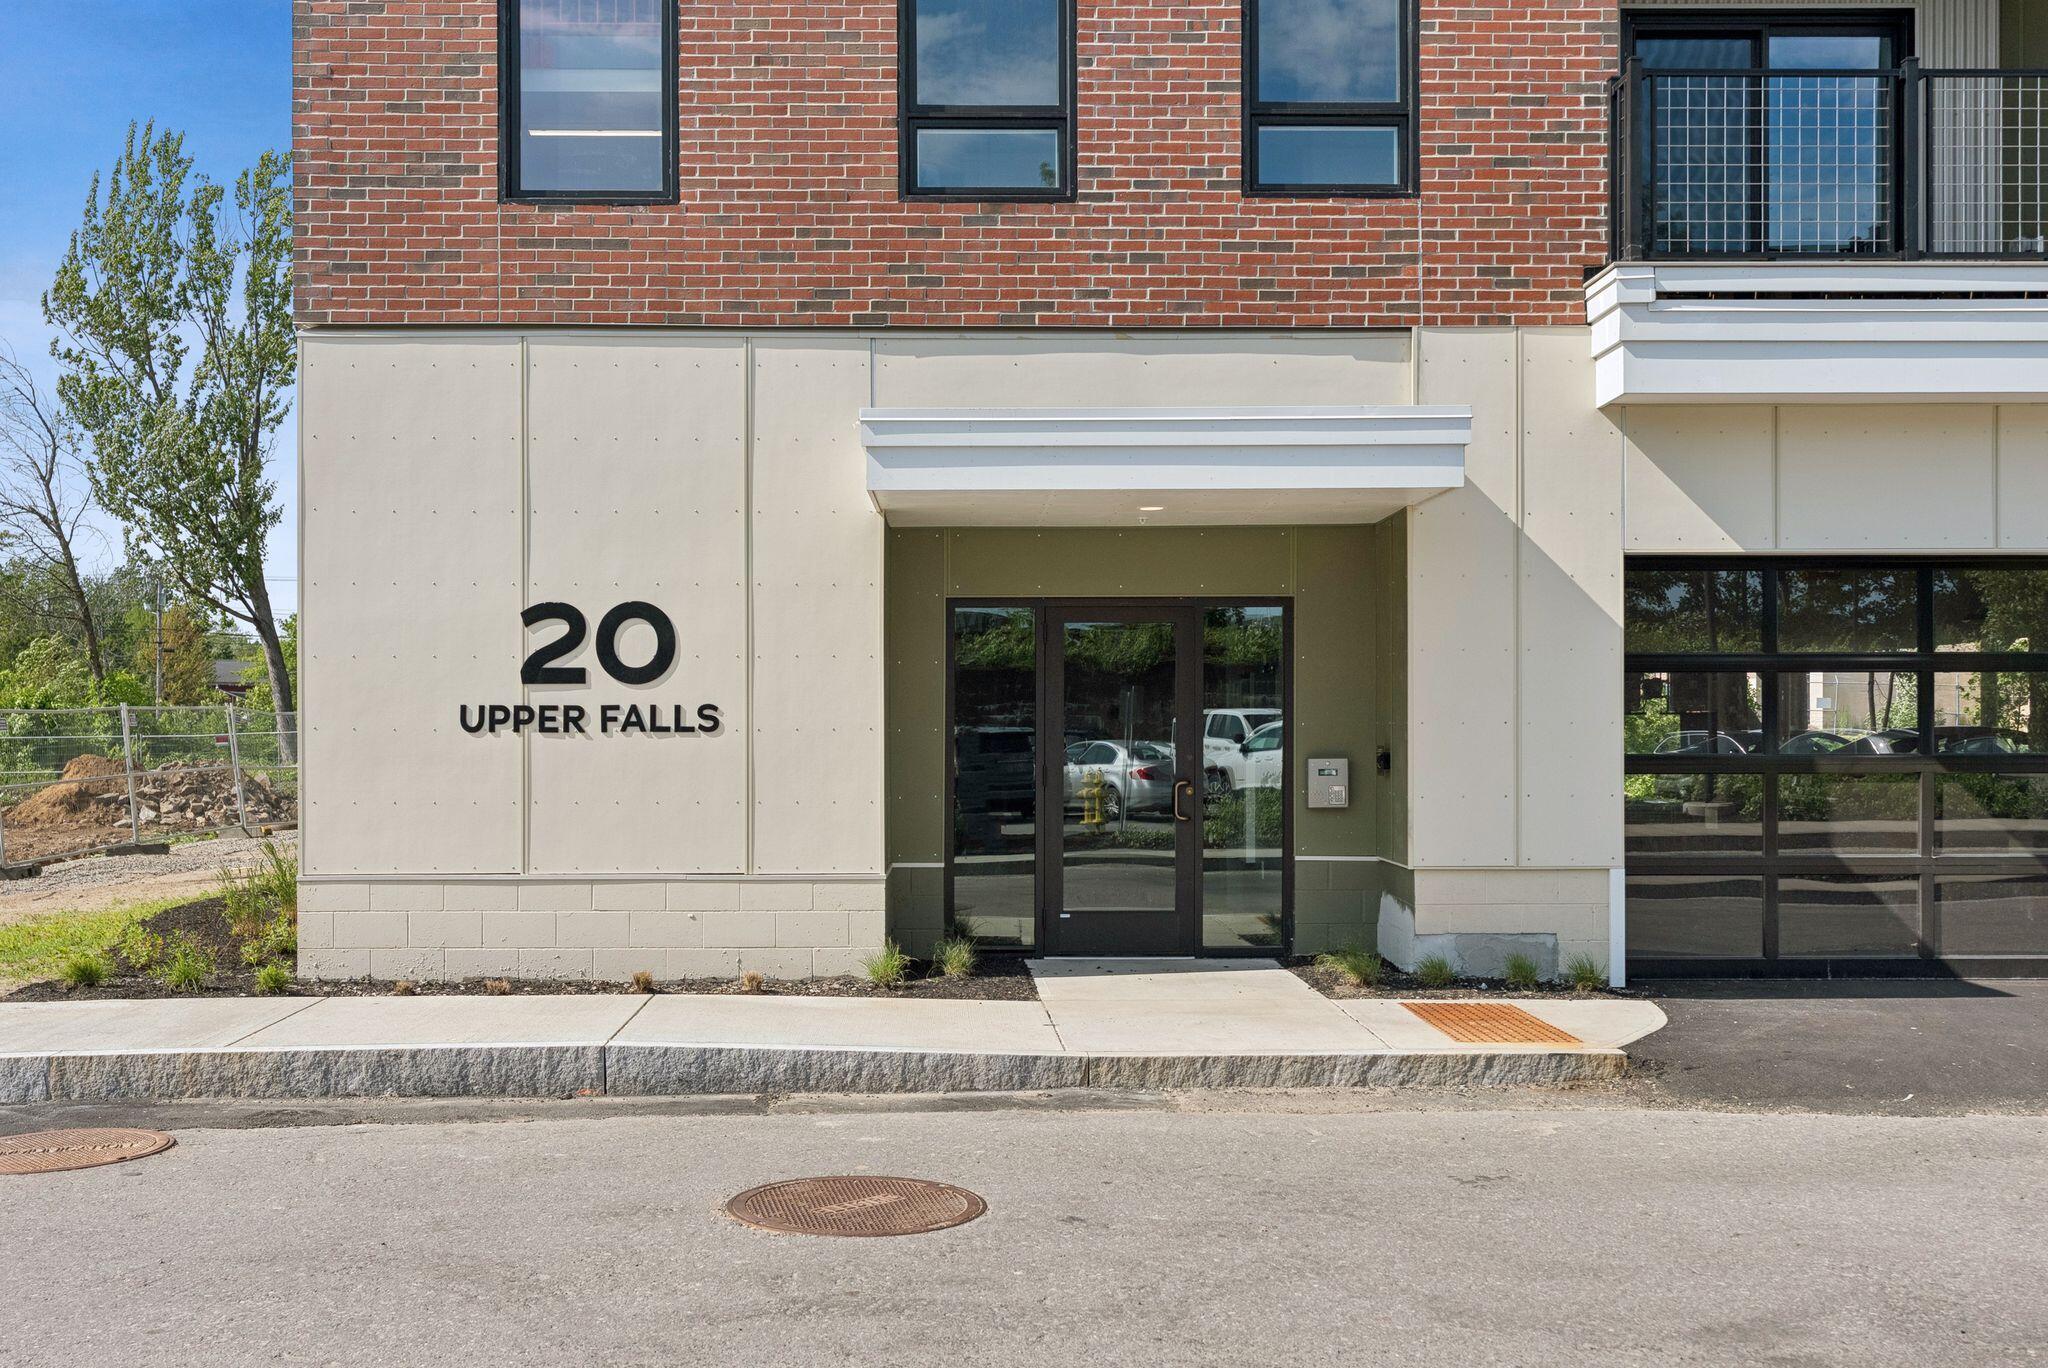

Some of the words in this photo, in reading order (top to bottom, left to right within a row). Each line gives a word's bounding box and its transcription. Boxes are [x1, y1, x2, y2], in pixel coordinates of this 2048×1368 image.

[520, 601, 676, 685] 20
[459, 704, 586, 733] UPPER
[600, 703, 720, 733] FALLS
